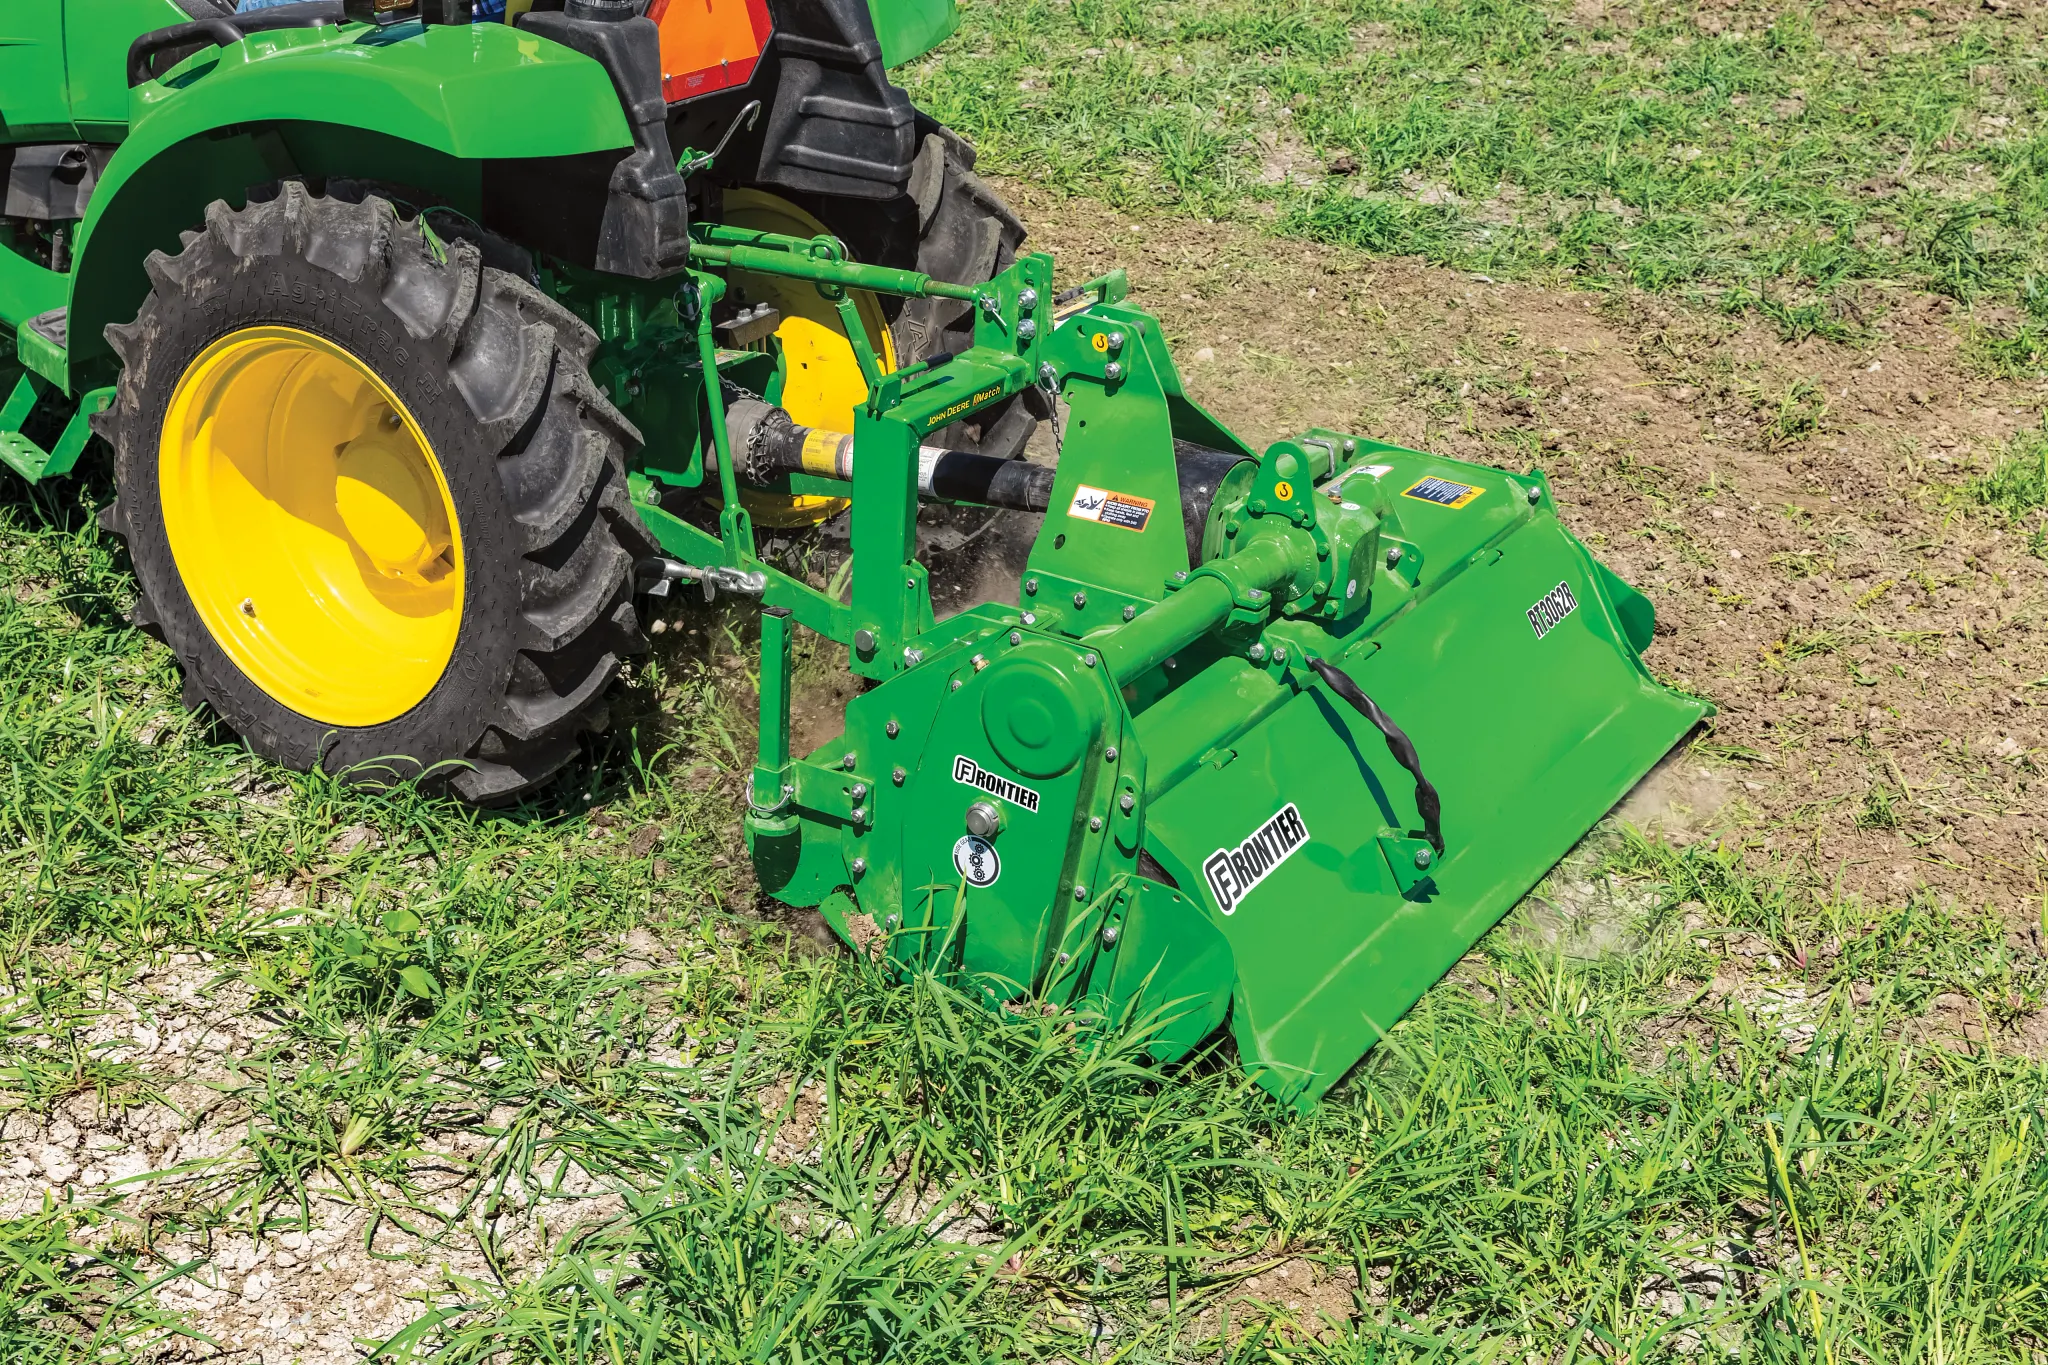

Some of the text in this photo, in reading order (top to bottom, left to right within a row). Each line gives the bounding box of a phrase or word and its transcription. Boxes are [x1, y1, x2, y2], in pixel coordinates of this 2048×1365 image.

[267, 271, 410, 368] AgriTrac
[927, 411, 946, 427] JOHN
[947, 400, 970, 417] DEERE
[1120, 496, 1149, 508] WARNING
[1526, 581, 1578, 639] RT3062R
[954, 756, 1039, 812] FRONTIER
[1204, 805, 1307, 912] FRONTIER
